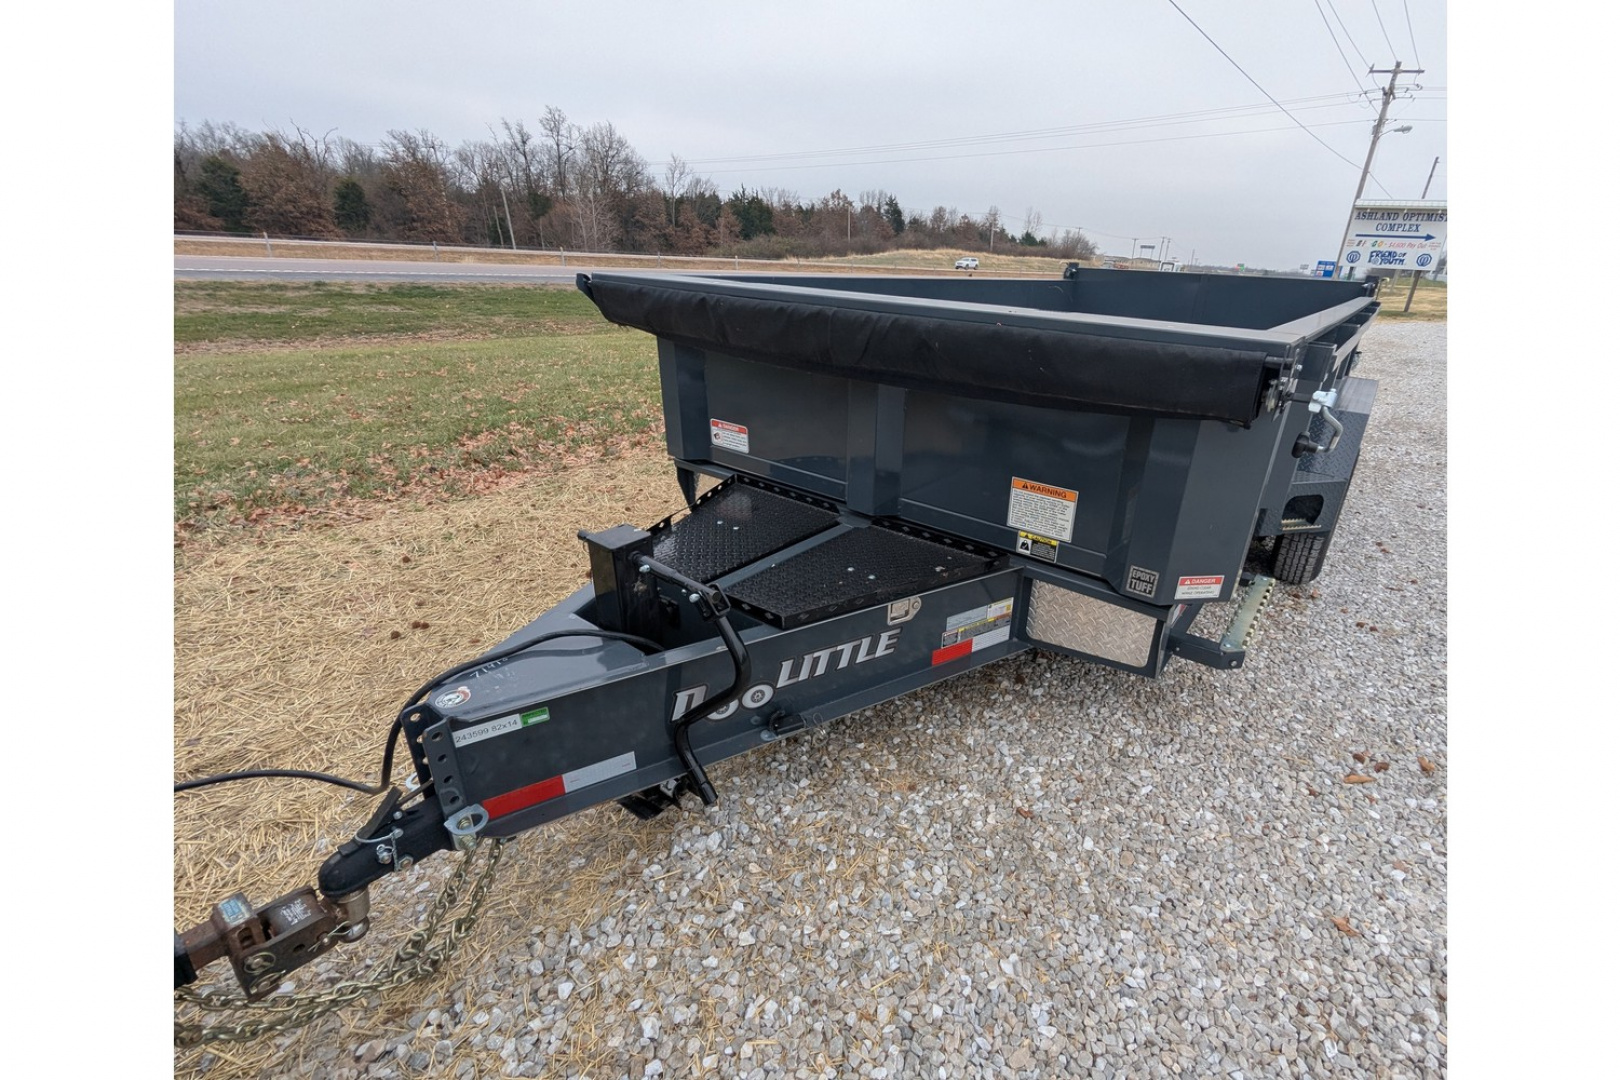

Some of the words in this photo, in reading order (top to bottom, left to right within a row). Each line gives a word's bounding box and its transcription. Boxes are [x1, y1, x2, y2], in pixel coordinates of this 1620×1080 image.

[1355, 211, 1399, 221] ASHLAND
[1375, 222, 1421, 232] COMPLEX
[1368, 250, 1397, 263] FRIEND
[1030, 484, 1067, 499] WARNING
[1132, 569, 1155, 582] EPOXY
[1130, 579, 1153, 594] TUFF
[776, 628, 901, 689] LITTLE
[455, 727, 489, 743] 243599
[491, 719, 518, 732] 82x14
